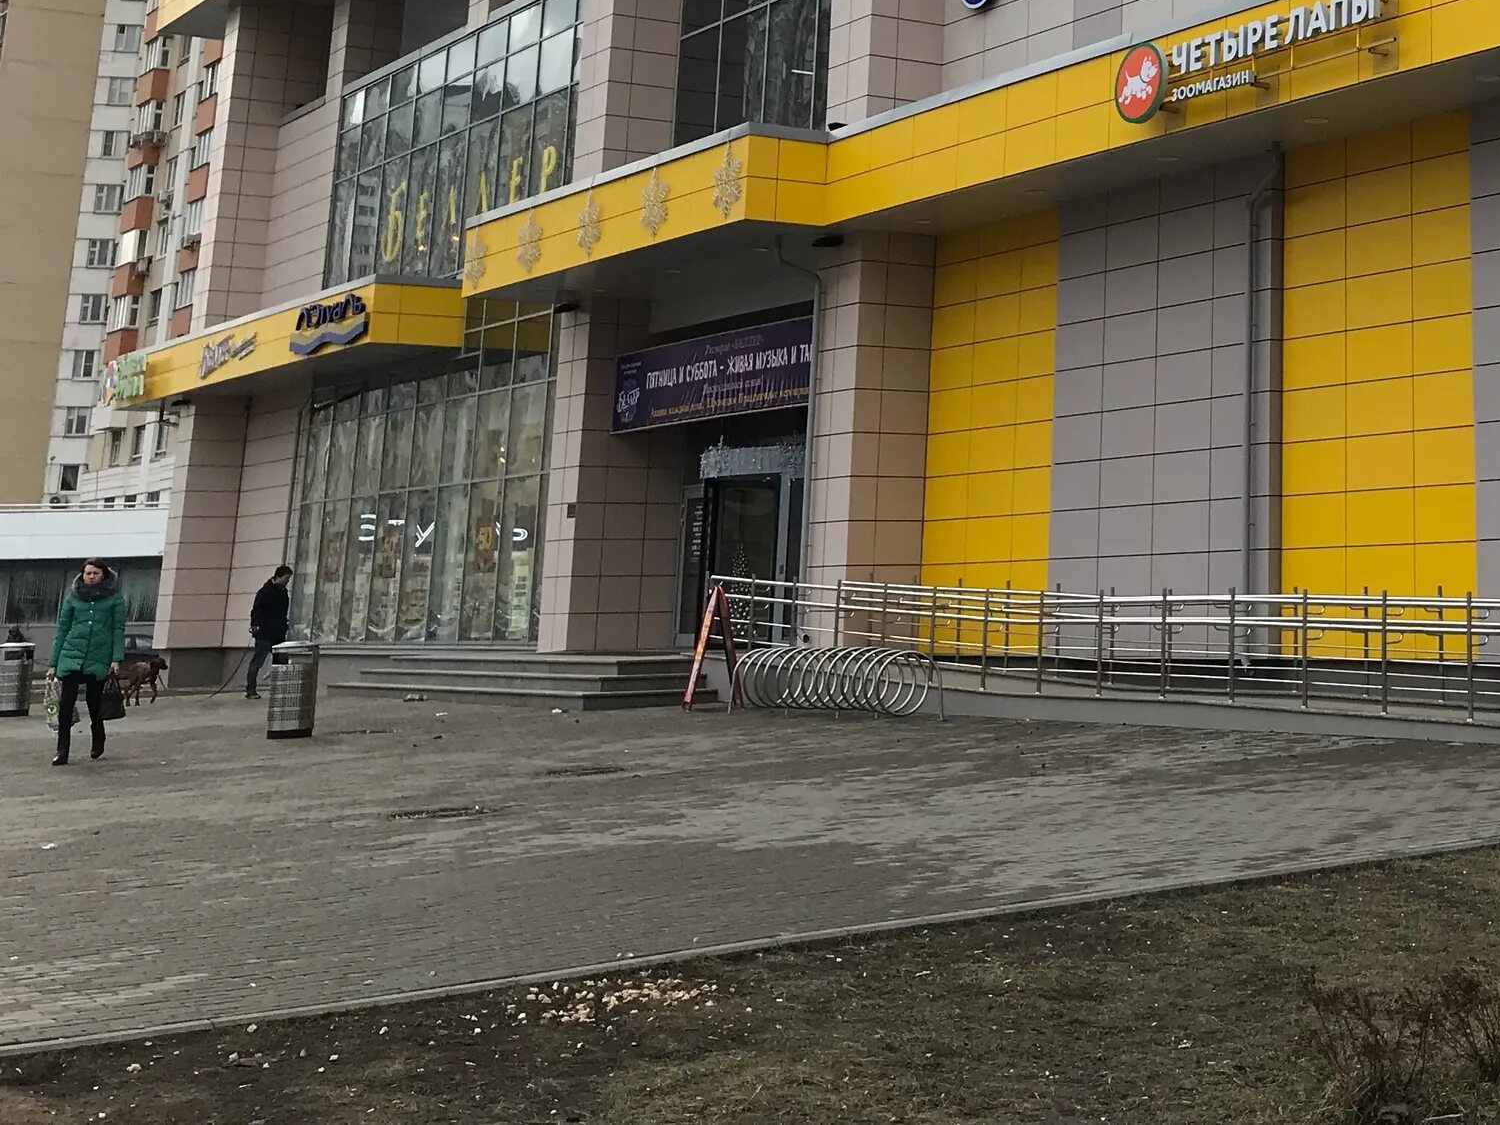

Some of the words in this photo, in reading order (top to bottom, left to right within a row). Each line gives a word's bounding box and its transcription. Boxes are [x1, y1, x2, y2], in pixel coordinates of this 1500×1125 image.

[1171, 15, 1278, 72] ЧЕТЫРЕ
[1170, 69, 1250, 102] ЗООМАГАЗИН
[646, 367, 677, 390] ПЯТНИЦА
[679, 366, 684, 384] И
[686, 360, 718, 382] СУББОТА
[727, 353, 753, 376] ЖИВАЯ
[756, 348, 788, 371] МУЗЫКА
[791, 348, 796, 365] И
